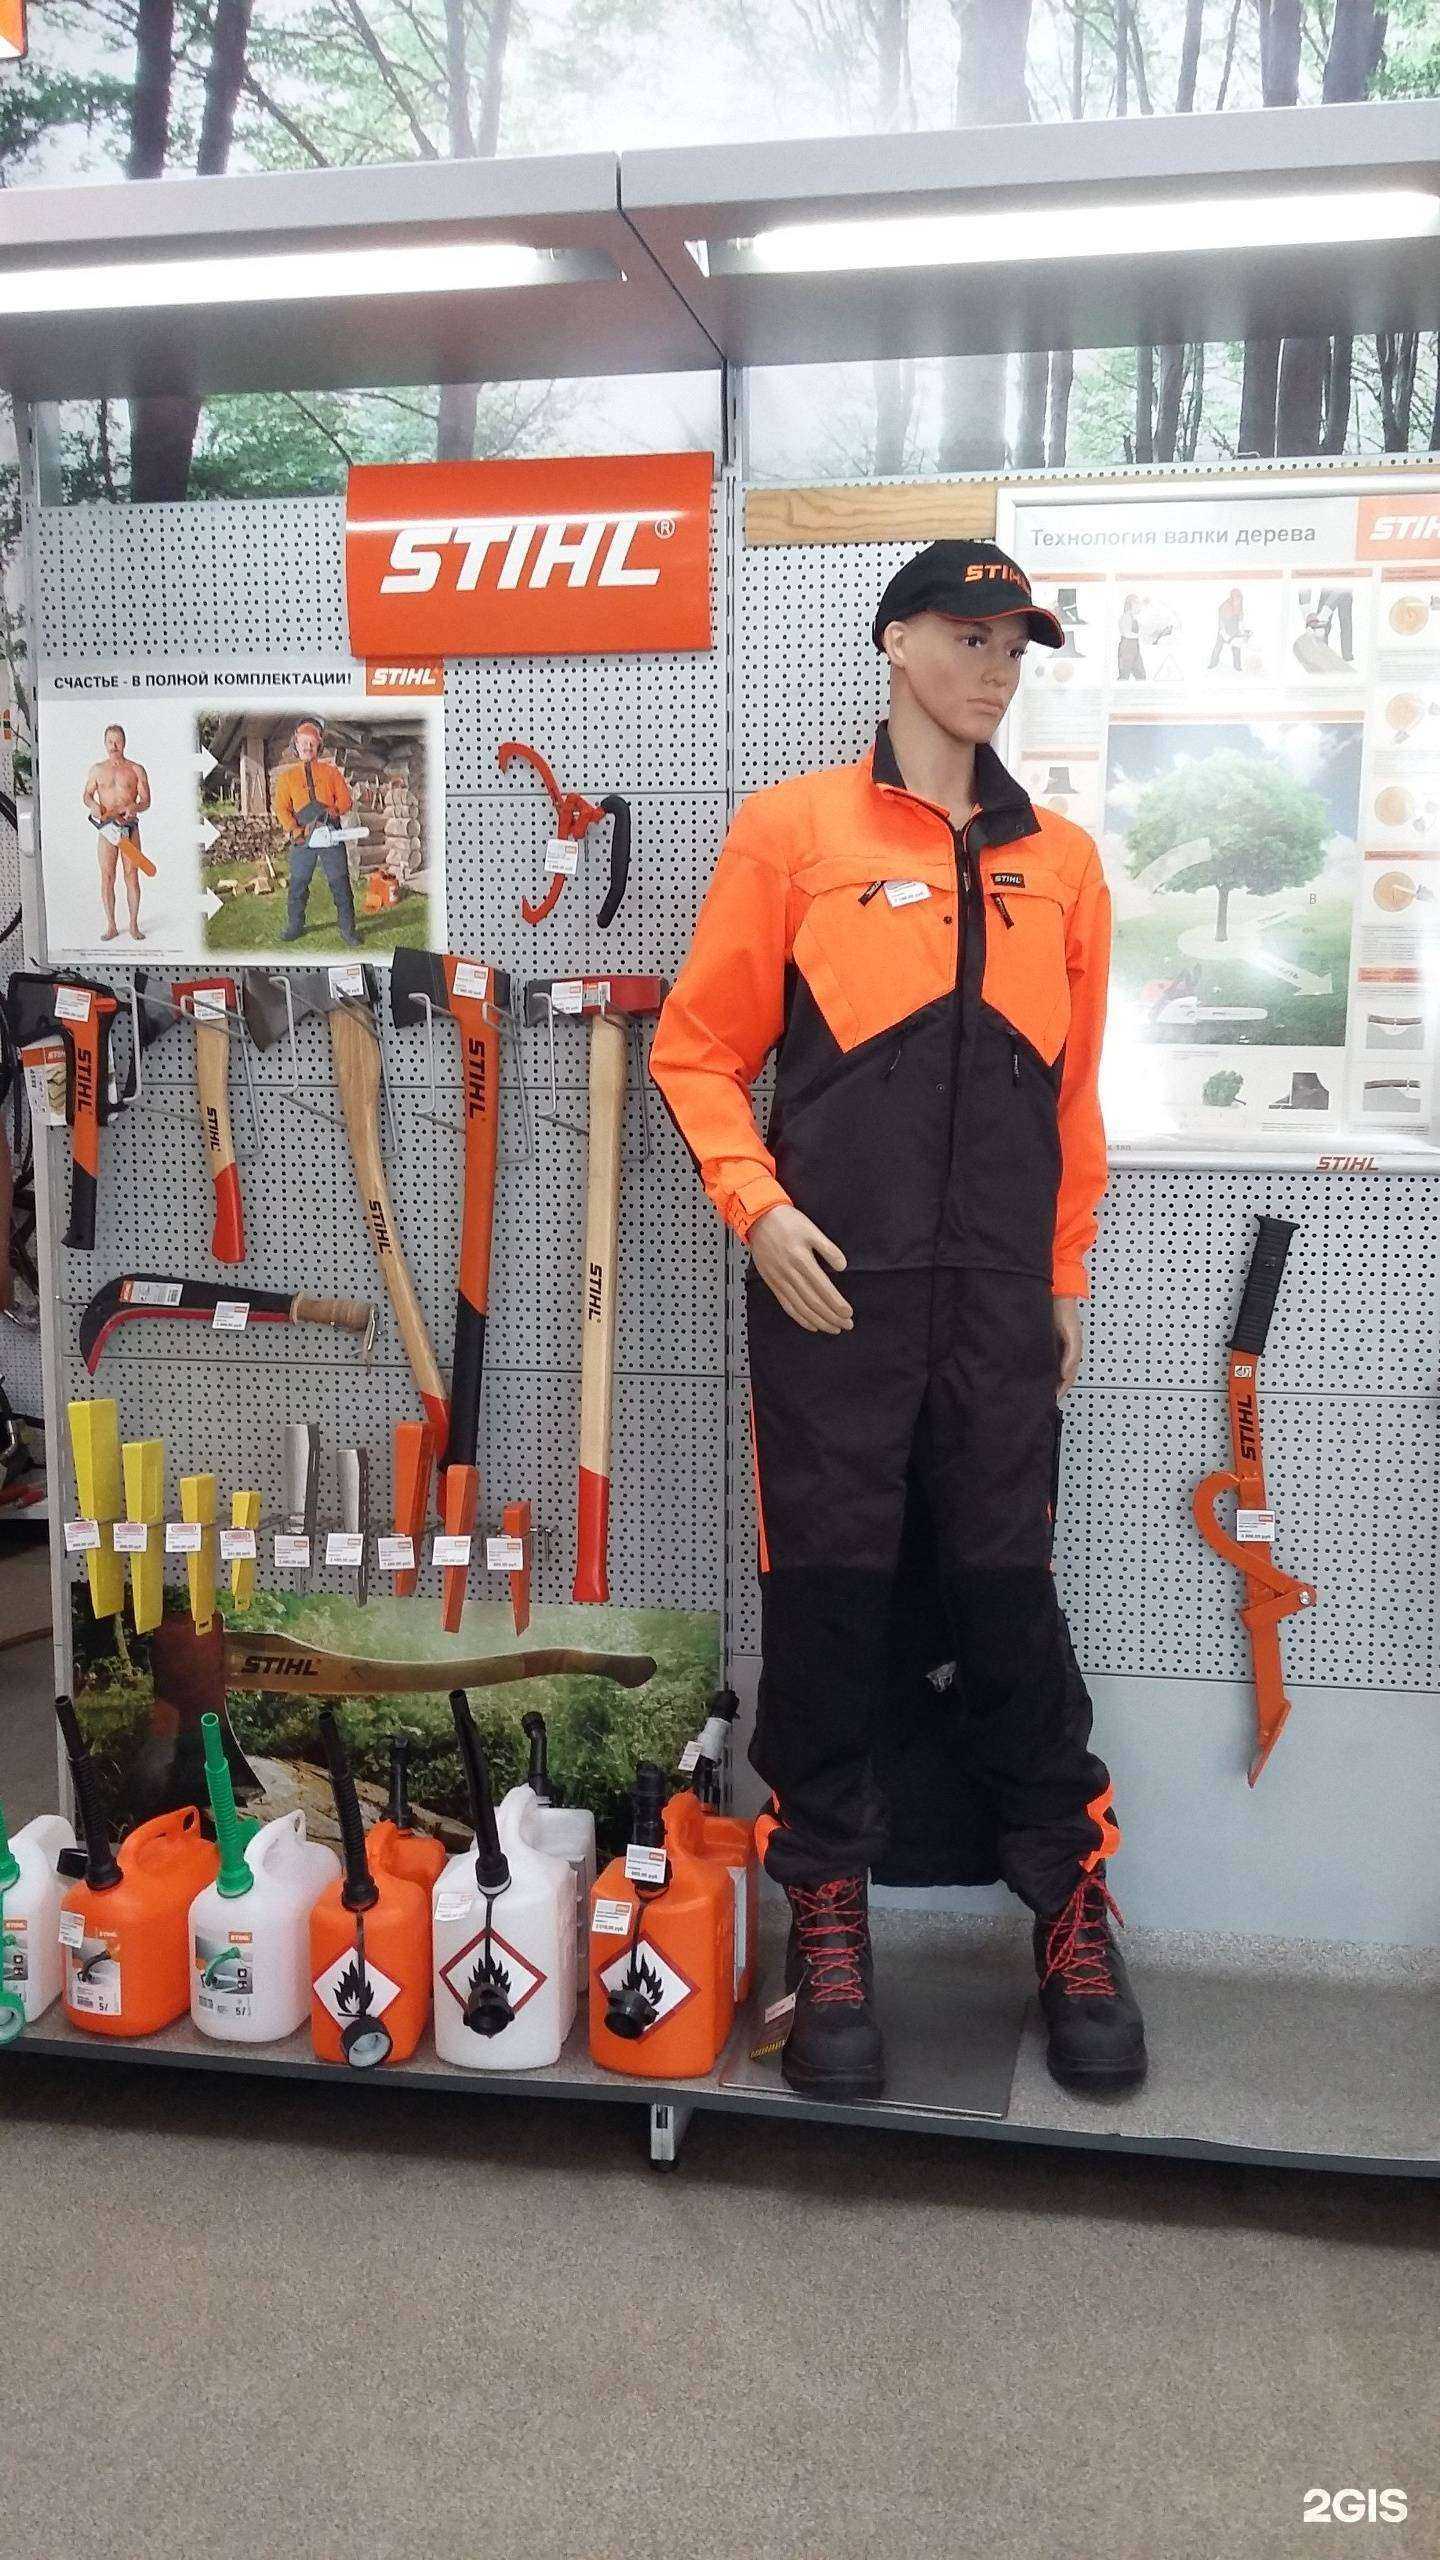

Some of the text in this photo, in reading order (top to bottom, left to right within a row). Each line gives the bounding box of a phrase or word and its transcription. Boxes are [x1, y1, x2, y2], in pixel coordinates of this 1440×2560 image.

[1031, 525, 1317, 548] Технология валки дерева
[54, 675, 119, 689] СЧАСТЬЕ
[132, 674, 141, 687] В
[145, 671, 210, 688] ПОЛНОЙ
[214, 671, 352, 688] КОМПЛЕКТАЦИИ!
[371, 667, 437, 686] STIHL
[994, 874, 1022, 884] STIHL
[77, 1048, 93, 1113] STIHL
[469, 1037, 486, 1119] STIHL
[207, 1106, 221, 1151] STIHL
[1315, 1156, 1380, 1171] STIHL
[369, 1200, 391, 1254] STIHL
[589, 1262, 602, 1320] STIHL
[1237, 1394, 1257, 1461] STIHL
[241, 1655, 319, 1676] STIHL
